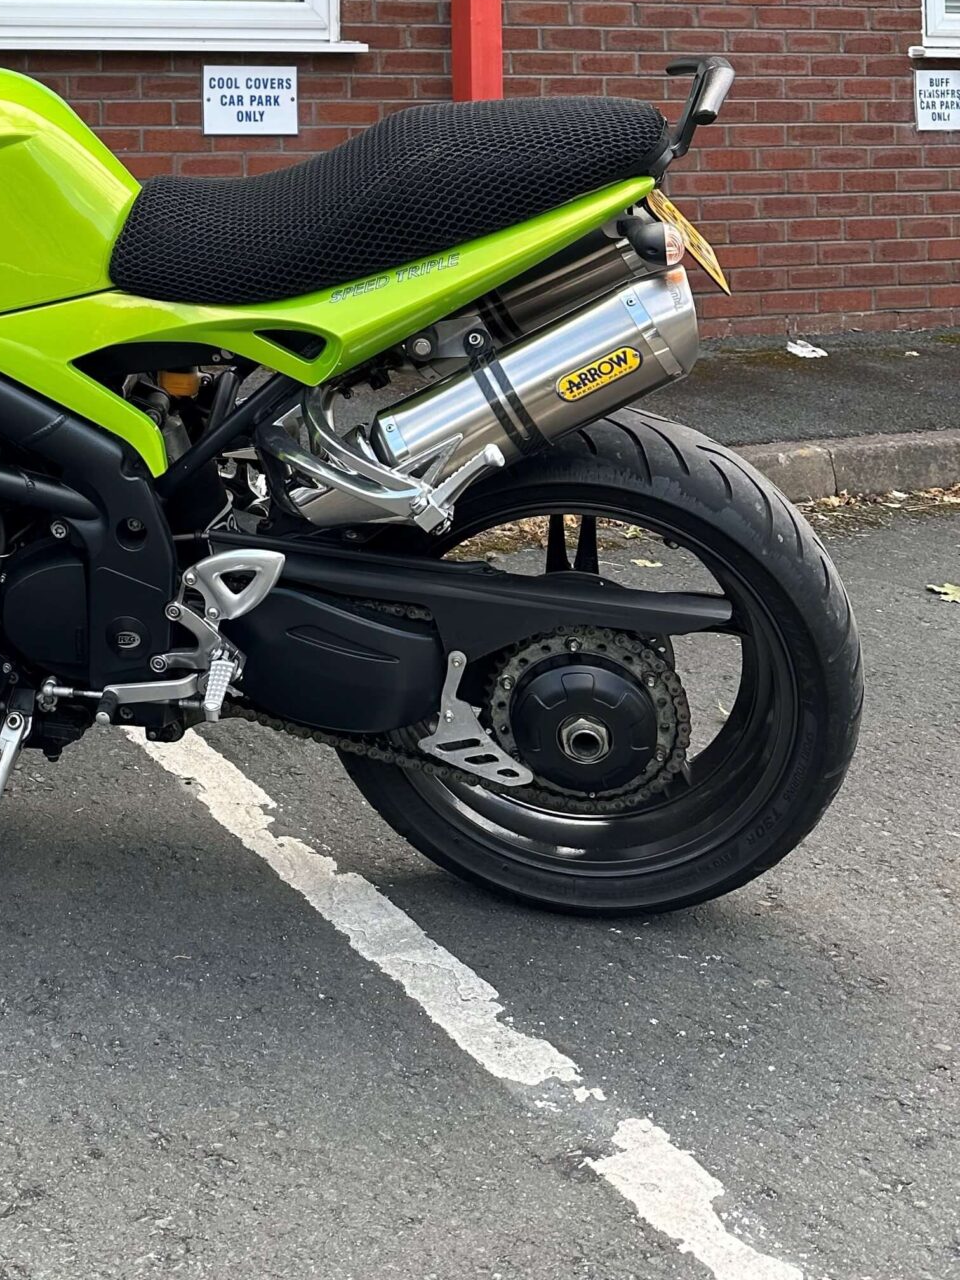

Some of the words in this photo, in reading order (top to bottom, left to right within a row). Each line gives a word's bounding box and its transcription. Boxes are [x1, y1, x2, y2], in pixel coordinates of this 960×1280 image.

[209, 77, 240, 89] COOL
[245, 77, 292, 90] COVERS
[929, 78, 950, 87] BUFF
[220, 94, 244, 106] CAR
[250, 95, 280, 106] PARK
[920, 100, 937, 110] CAR
[236, 110, 265, 122] ONLY
[330, 275, 390, 303] SPEED
[395, 252, 460, 283] TRIPLE
[566, 350, 628, 394] ARROW
